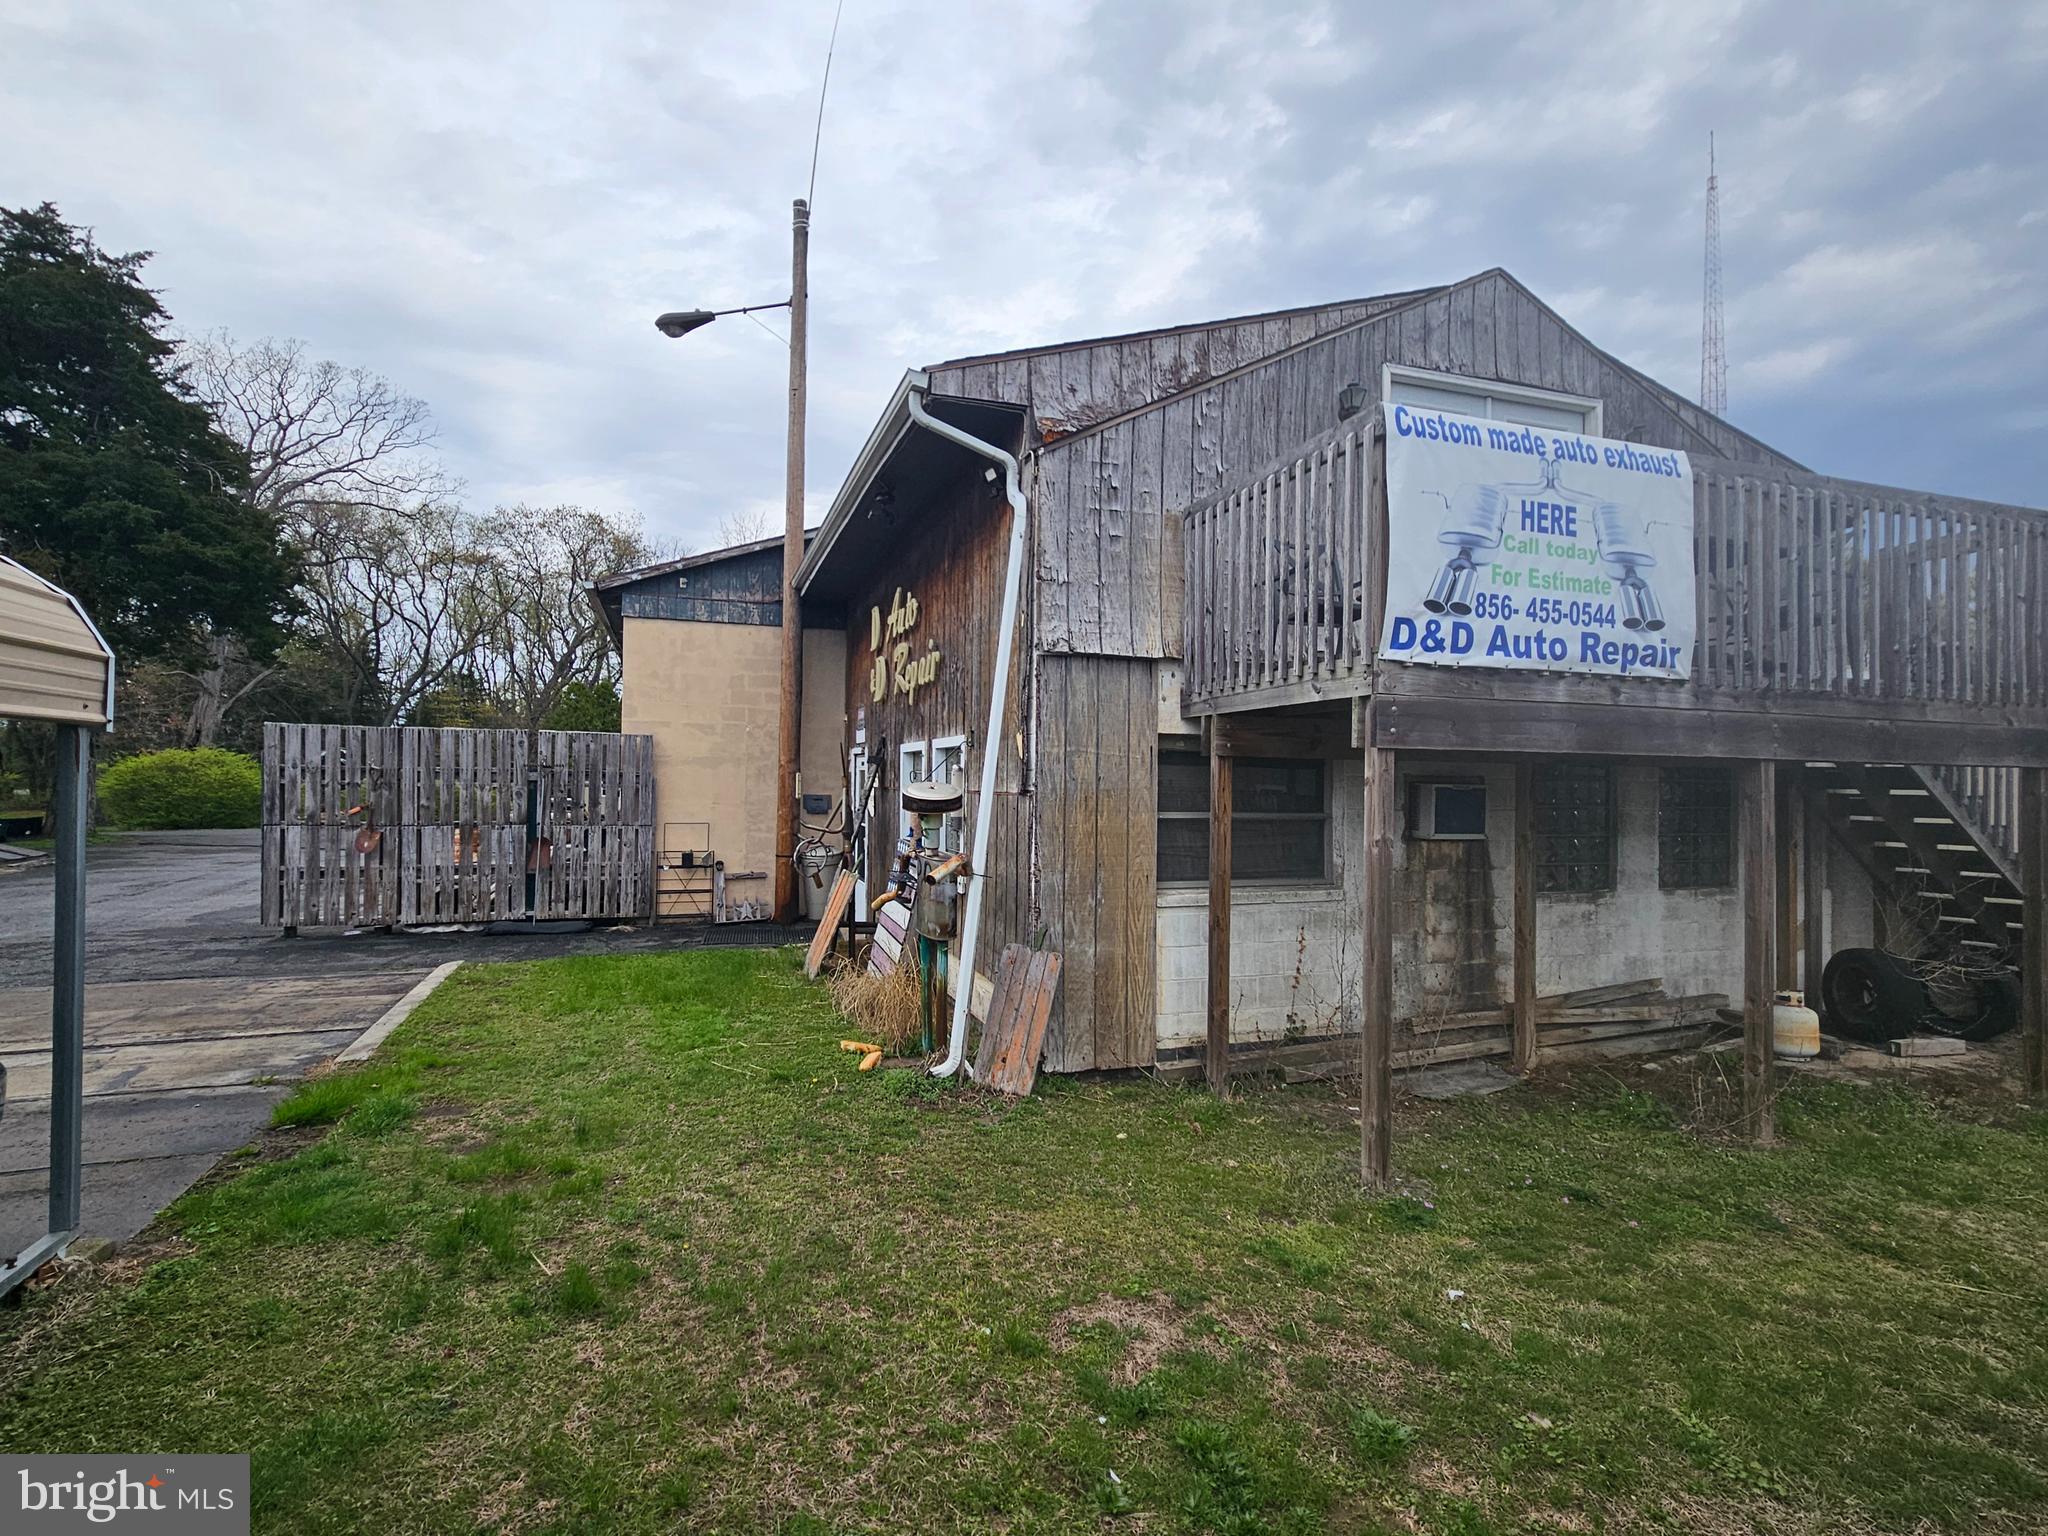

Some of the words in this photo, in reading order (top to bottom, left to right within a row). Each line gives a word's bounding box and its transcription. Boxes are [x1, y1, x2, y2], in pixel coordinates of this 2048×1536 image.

[1394, 406, 1482, 447] Custom
[1487, 427, 1547, 458] made
[1550, 436, 1598, 465] auto
[1604, 444, 1682, 479] exhaust
[1520, 499, 1578, 538] HERE
[1503, 534, 1540, 555] Call
[1546, 541, 1600, 565] today
[1491, 564, 1522, 586] For
[1527, 568, 1612, 596] Estimate
[1525, 597, 1617, 629] 455-0544
[1389, 616, 1475, 655] D&D
[1485, 624, 1569, 662] Auto
[1579, 631, 1682, 673] Repair
[894, 639, 941, 705] Repair
